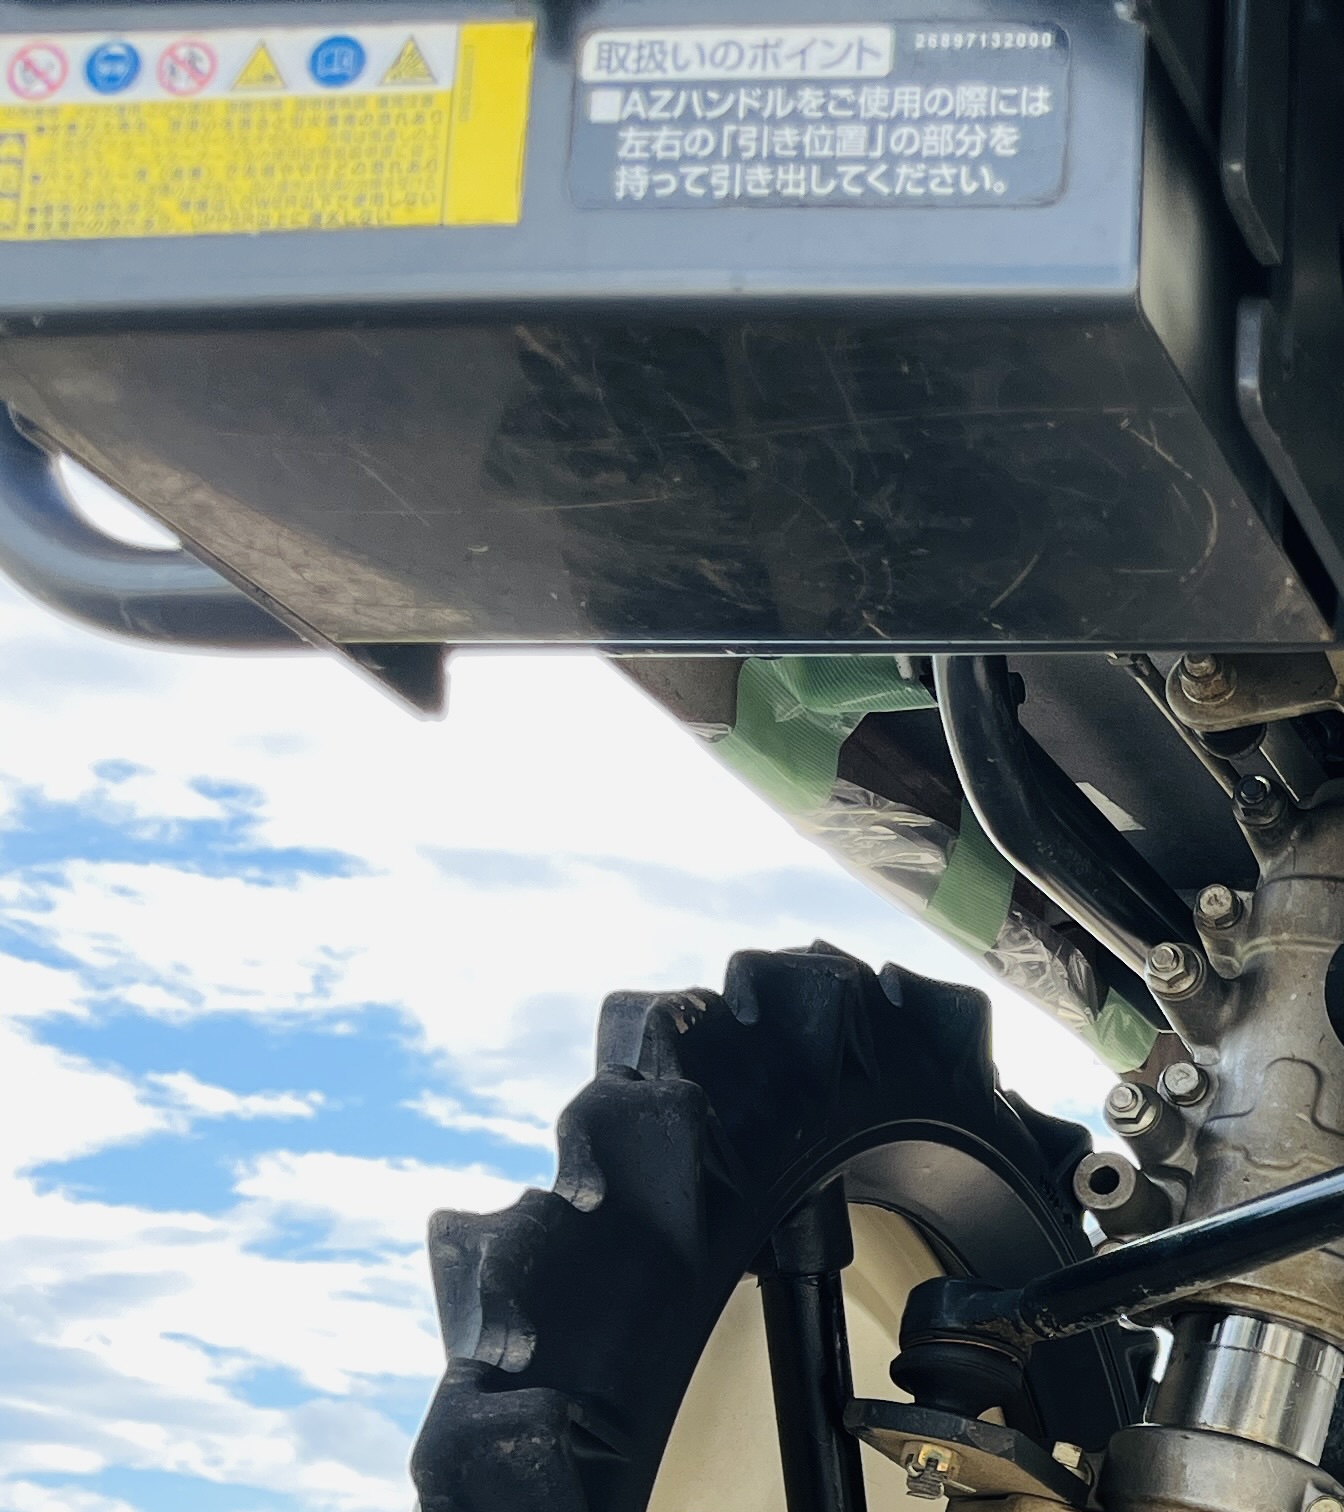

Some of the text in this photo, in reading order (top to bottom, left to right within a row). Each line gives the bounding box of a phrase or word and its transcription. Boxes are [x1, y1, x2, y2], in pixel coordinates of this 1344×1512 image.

[594, 39, 884, 75] 取扱いのポイント
[616, 122, 1021, 161] 左右の「引き位置」の部分を
[614, 162, 1009, 201] 持って引き出してください。
